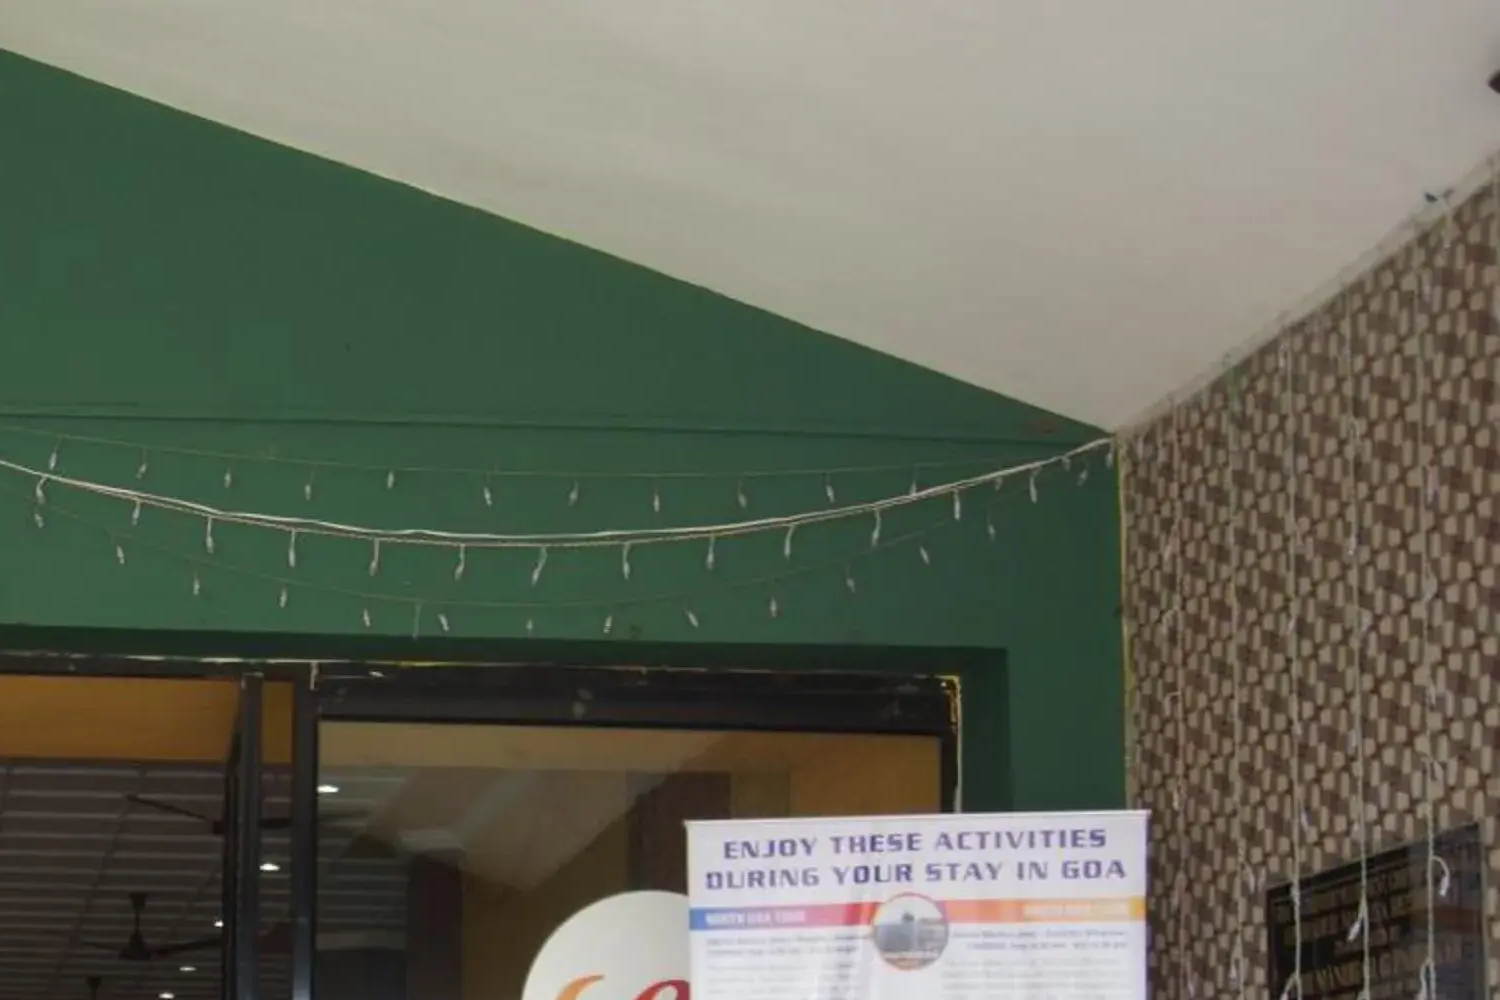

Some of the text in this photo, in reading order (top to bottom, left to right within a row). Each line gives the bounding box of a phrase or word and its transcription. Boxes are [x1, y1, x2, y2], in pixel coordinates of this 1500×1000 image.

[723, 829, 1107, 859] ENJOY THESE ACTIVITIES
[706, 859, 1127, 890] DURING YOUR STAY IN GOA
